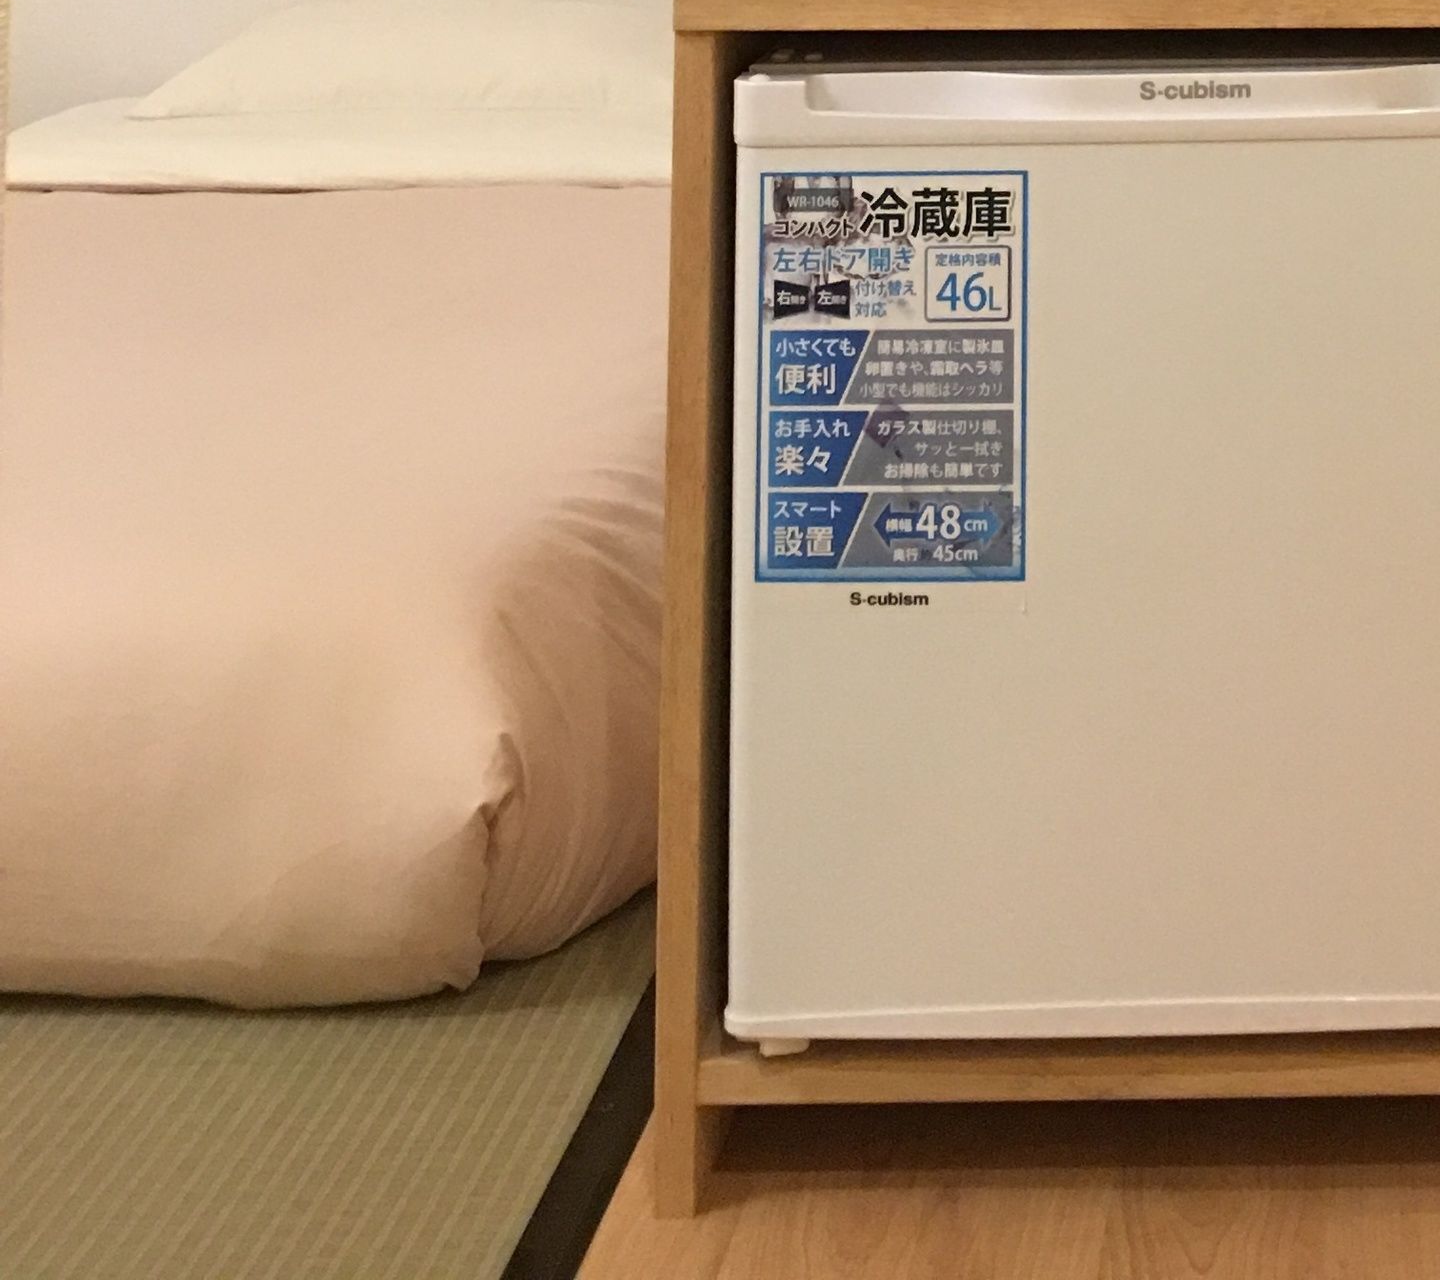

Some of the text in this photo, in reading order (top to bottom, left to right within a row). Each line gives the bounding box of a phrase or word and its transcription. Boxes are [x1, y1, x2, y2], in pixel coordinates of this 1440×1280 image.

[1139, 80, 1252, 101] S-cubism
[787, 195, 839, 208] WR-1046
[859, 187, 1012, 238] 冷蔵庫
[773, 247, 915, 272] 左右ドア開き
[936, 272, 1002, 312] 46L
[775, 338, 856, 357] 小さくても
[775, 363, 836, 395] 便利
[774, 419, 851, 438] お手入れ
[775, 446, 831, 476] 楽々
[774, 500, 842, 519] スマート
[774, 526, 835, 557] 設置
[849, 592, 929, 607] S-cubism
